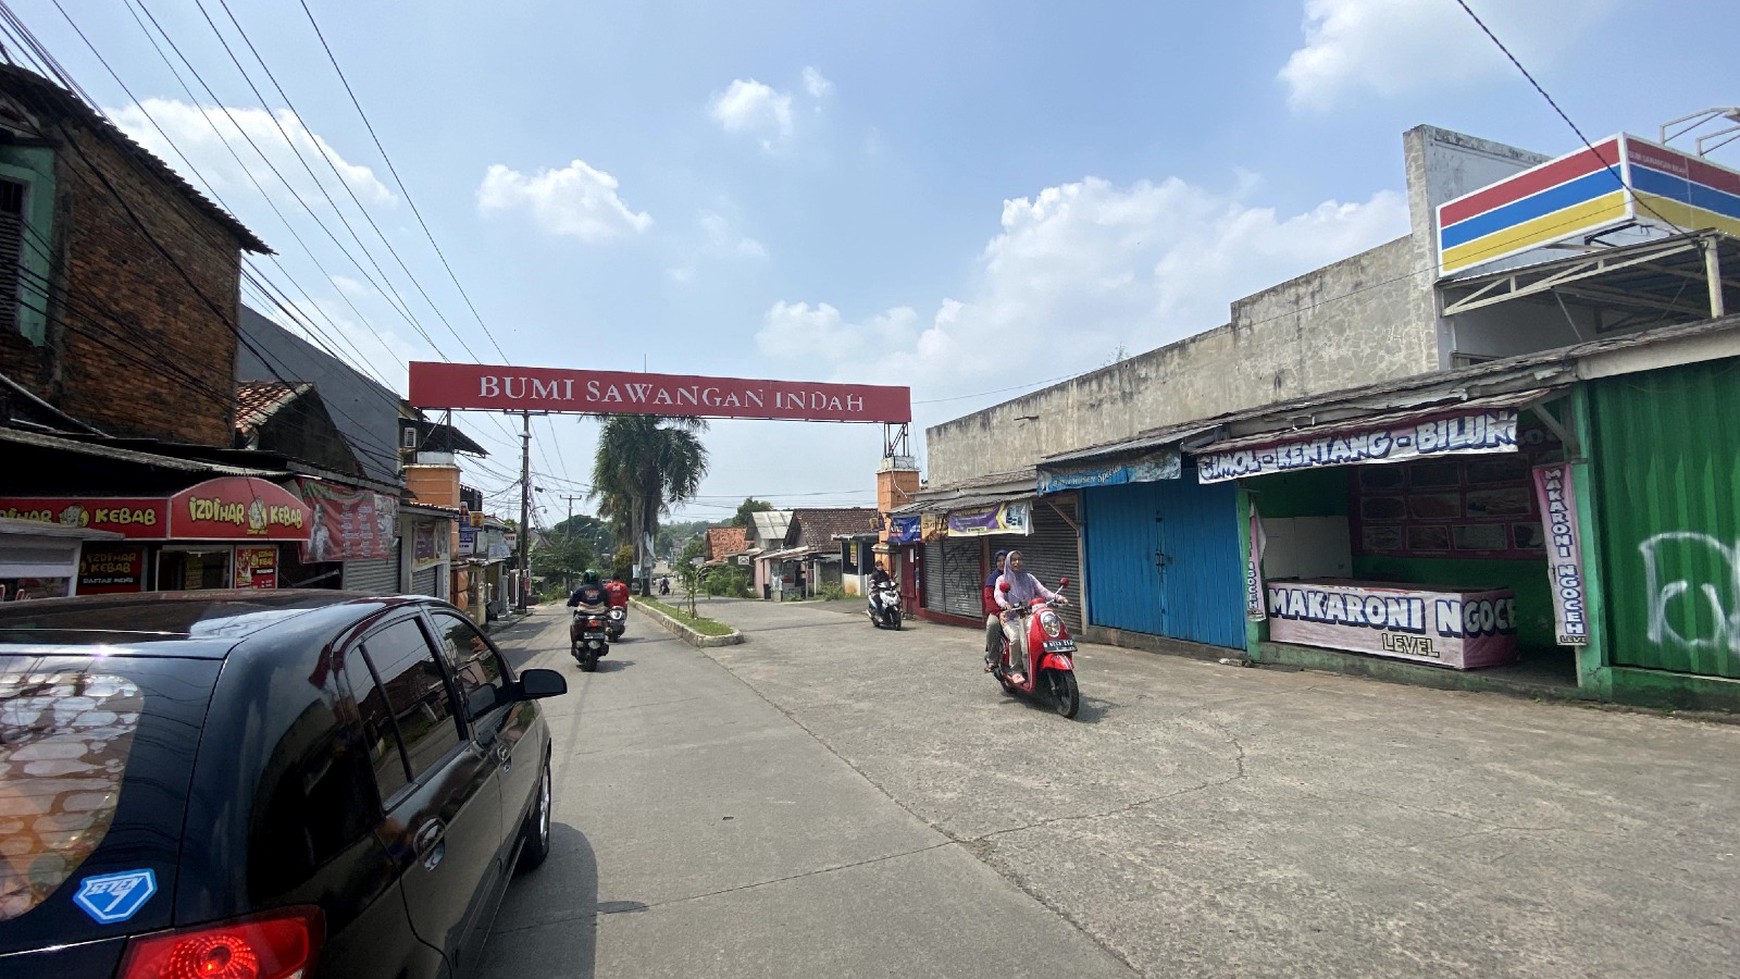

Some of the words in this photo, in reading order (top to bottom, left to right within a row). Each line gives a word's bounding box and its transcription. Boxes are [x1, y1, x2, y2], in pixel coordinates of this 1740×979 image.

[479, 375, 574, 400] BUMI
[586, 381, 764, 408] SAWANGAN
[774, 391, 865, 413] INDAH
[1276, 431, 1393, 469] KENTANG
[95, 507, 157, 526] KEBAB
[269, 505, 303, 529] KEBAB
[1544, 469, 1573, 557] MAKARONI
[90, 562, 132, 573] KEBAB
[1268, 588, 1426, 635] MAKARONI
[1557, 564, 1586, 635] NGOCEH
[1382, 632, 1440, 658] LEVEL
